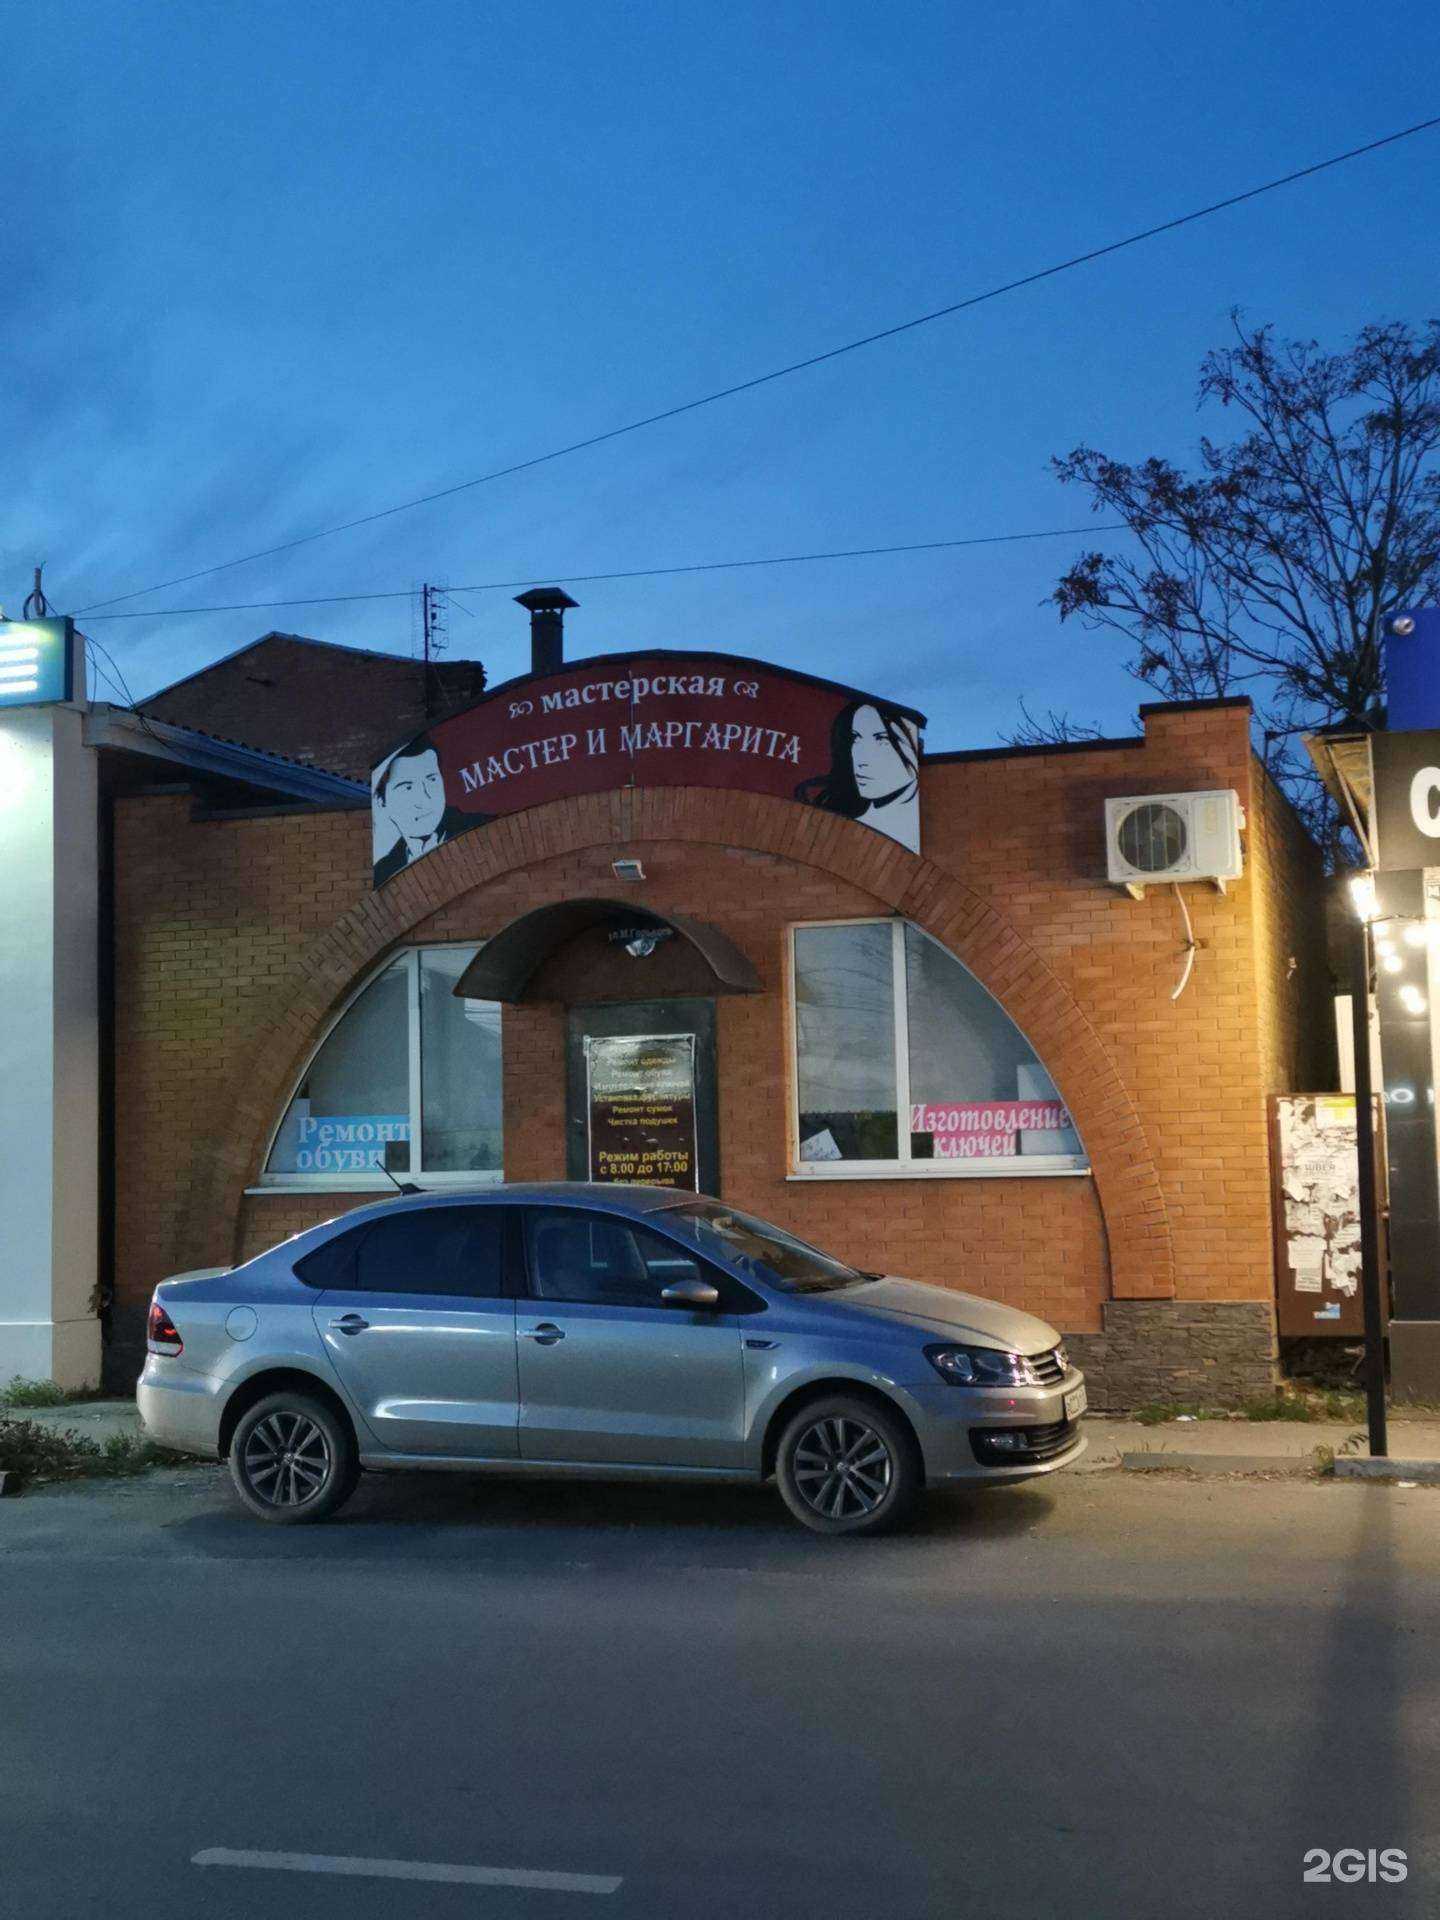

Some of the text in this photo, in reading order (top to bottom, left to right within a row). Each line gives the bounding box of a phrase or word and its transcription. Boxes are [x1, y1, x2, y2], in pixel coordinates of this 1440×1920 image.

[540, 675, 726, 714] мастерская
[457, 720, 802, 794] МАСТЕР И МАРГАРИТА
[298, 1116, 410, 1143] Ремонт
[910, 1103, 1070, 1134] Изготовление
[297, 1142, 386, 1173] обуви
[599, 1149, 689, 1164] Режим работы
[600, 1165, 607, 1174] с
[610, 1163, 634, 1175] 8.00
[637, 1164, 653, 1175] до
